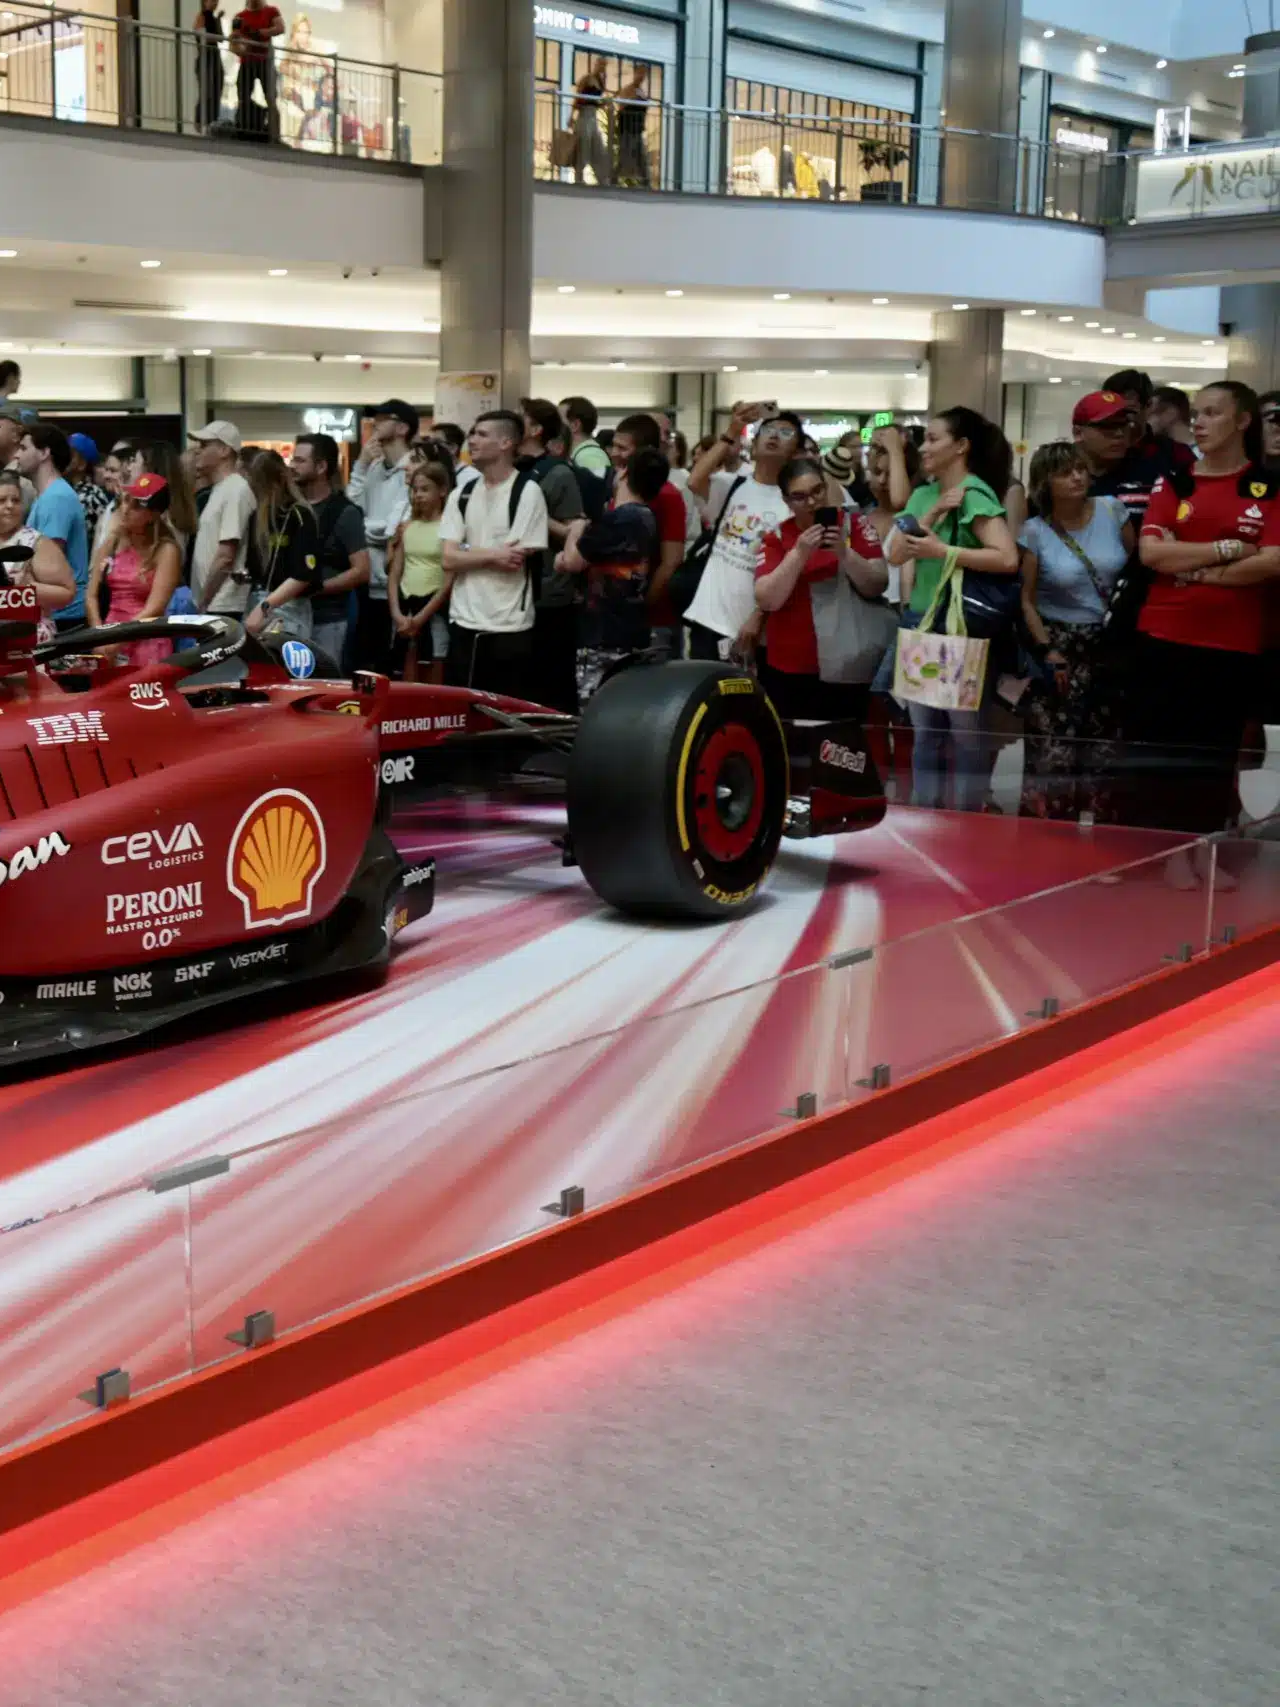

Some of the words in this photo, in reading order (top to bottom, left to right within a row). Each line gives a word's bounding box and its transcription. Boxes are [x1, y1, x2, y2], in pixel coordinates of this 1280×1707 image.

[287, 642, 313, 679] hp
[129, 681, 164, 702] aws
[26, 710, 110, 745] IBM
[380, 717, 432, 736] RICHARD
[433, 713, 468, 731] MILLE
[148, 850, 205, 871] LOGISTICS
[105, 880, 204, 923] PERONI
[106, 919, 152, 935] NASTRO
[154, 909, 204, 926] AZZURRO
[113, 970, 153, 993] NGK
[173, 961, 216, 983] SKF
[36, 979, 98, 1000] MAHLE
